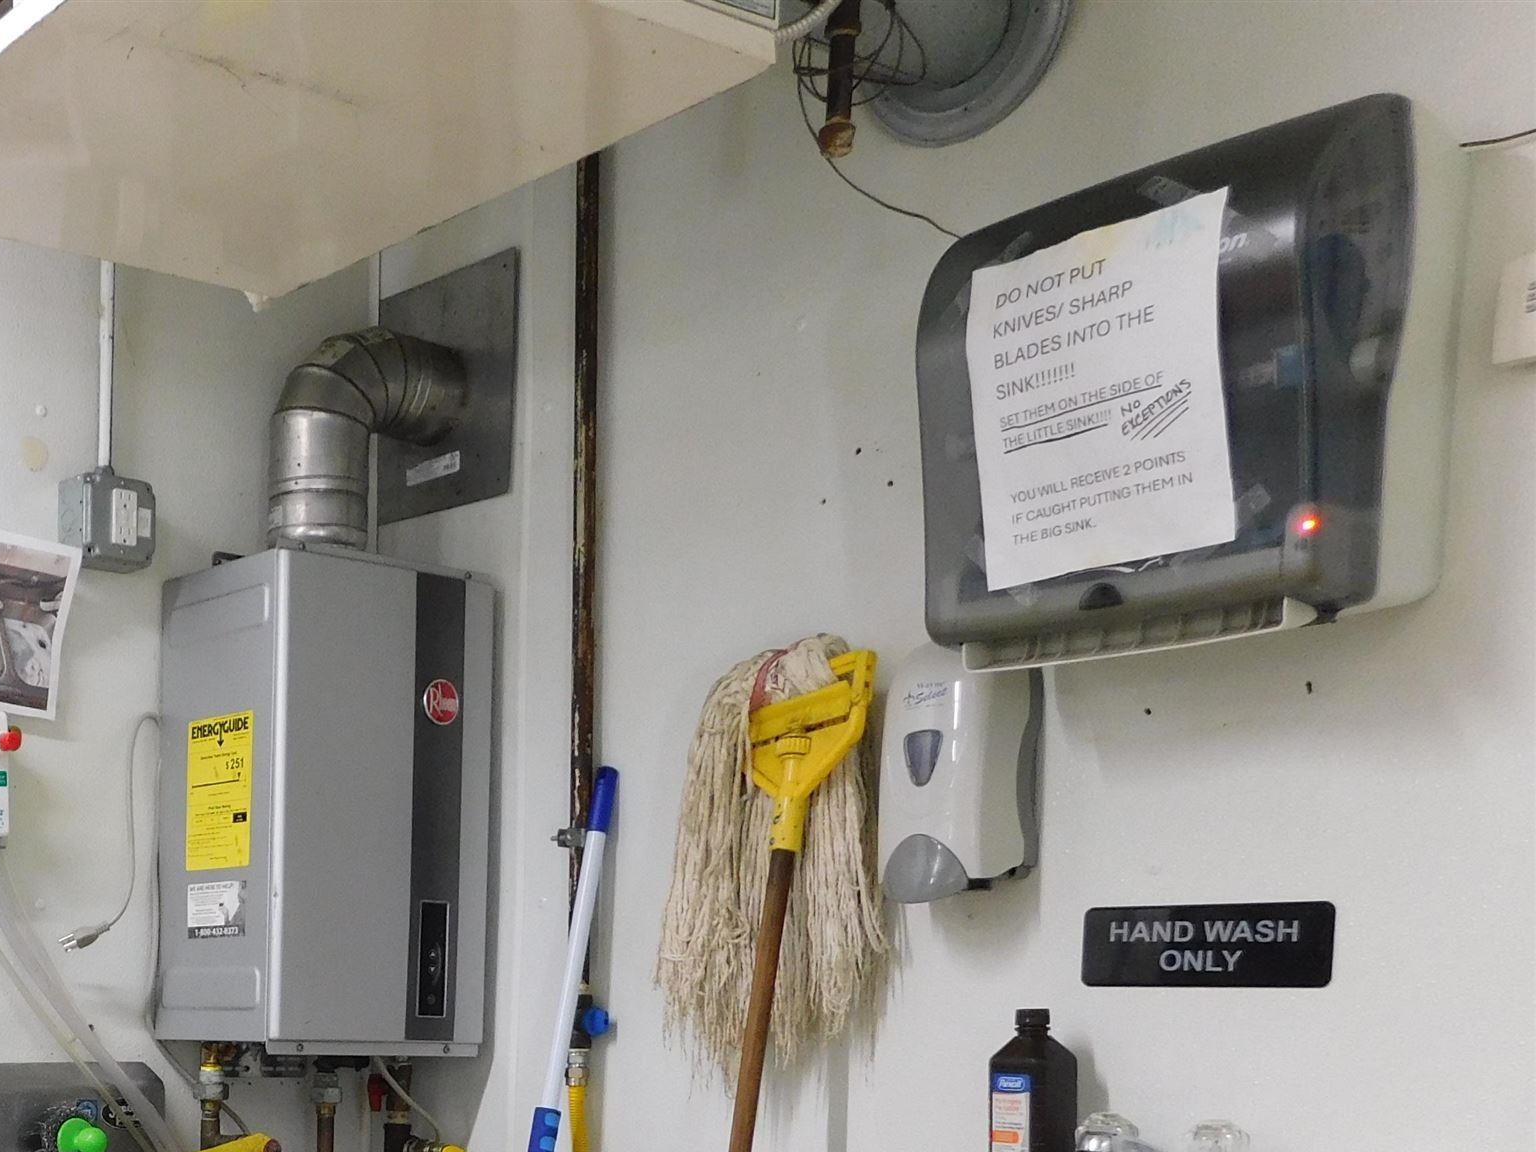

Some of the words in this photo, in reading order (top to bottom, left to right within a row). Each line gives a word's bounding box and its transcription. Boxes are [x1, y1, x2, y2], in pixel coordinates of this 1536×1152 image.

[992, 302, 1065, 339] KNIVES/
[1068, 280, 1133, 315] SHARP
[995, 287, 1022, 309] DO
[1026, 272, 1066, 298] NOT
[1069, 258, 1107, 284] PUT
[994, 334, 1062, 370] BLADES
[1067, 319, 1111, 348] INTO
[1116, 304, 1156, 331] THE
[999, 409, 1022, 430] SET
[1019, 403, 1056, 422] THEM
[1058, 396, 1079, 412] ON
[1080, 386, 1110, 404] THE
[1110, 376, 1142, 397] SIDE
[1144, 370, 1164, 388] OF
[1121, 378, 1192, 437] EXCEPTIONS
[1002, 433, 1025, 450] THE
[1026, 421, 1064, 443] LITTLE
[1009, 488, 1037, 504] YOU
[1037, 480, 1068, 498] WILL
[1070, 465, 1121, 490] RECEIVE
[1123, 463, 1131, 476] 2
[1134, 450, 1187, 474] POINTS
[1011, 512, 1024, 526] IF
[1025, 499, 1078, 522] CAUGHT
[1079, 486, 1132, 509] PUTTING
[1133, 476, 1175, 496] THEM
[1177, 471, 1194, 486] IN
[1011, 532, 1039, 546] THE
[1040, 525, 1063, 541] BIG
[1109, 920, 1195, 943] HAND
[1203, 919, 1300, 943] WASH
[1158, 949, 1244, 973] ONLY
